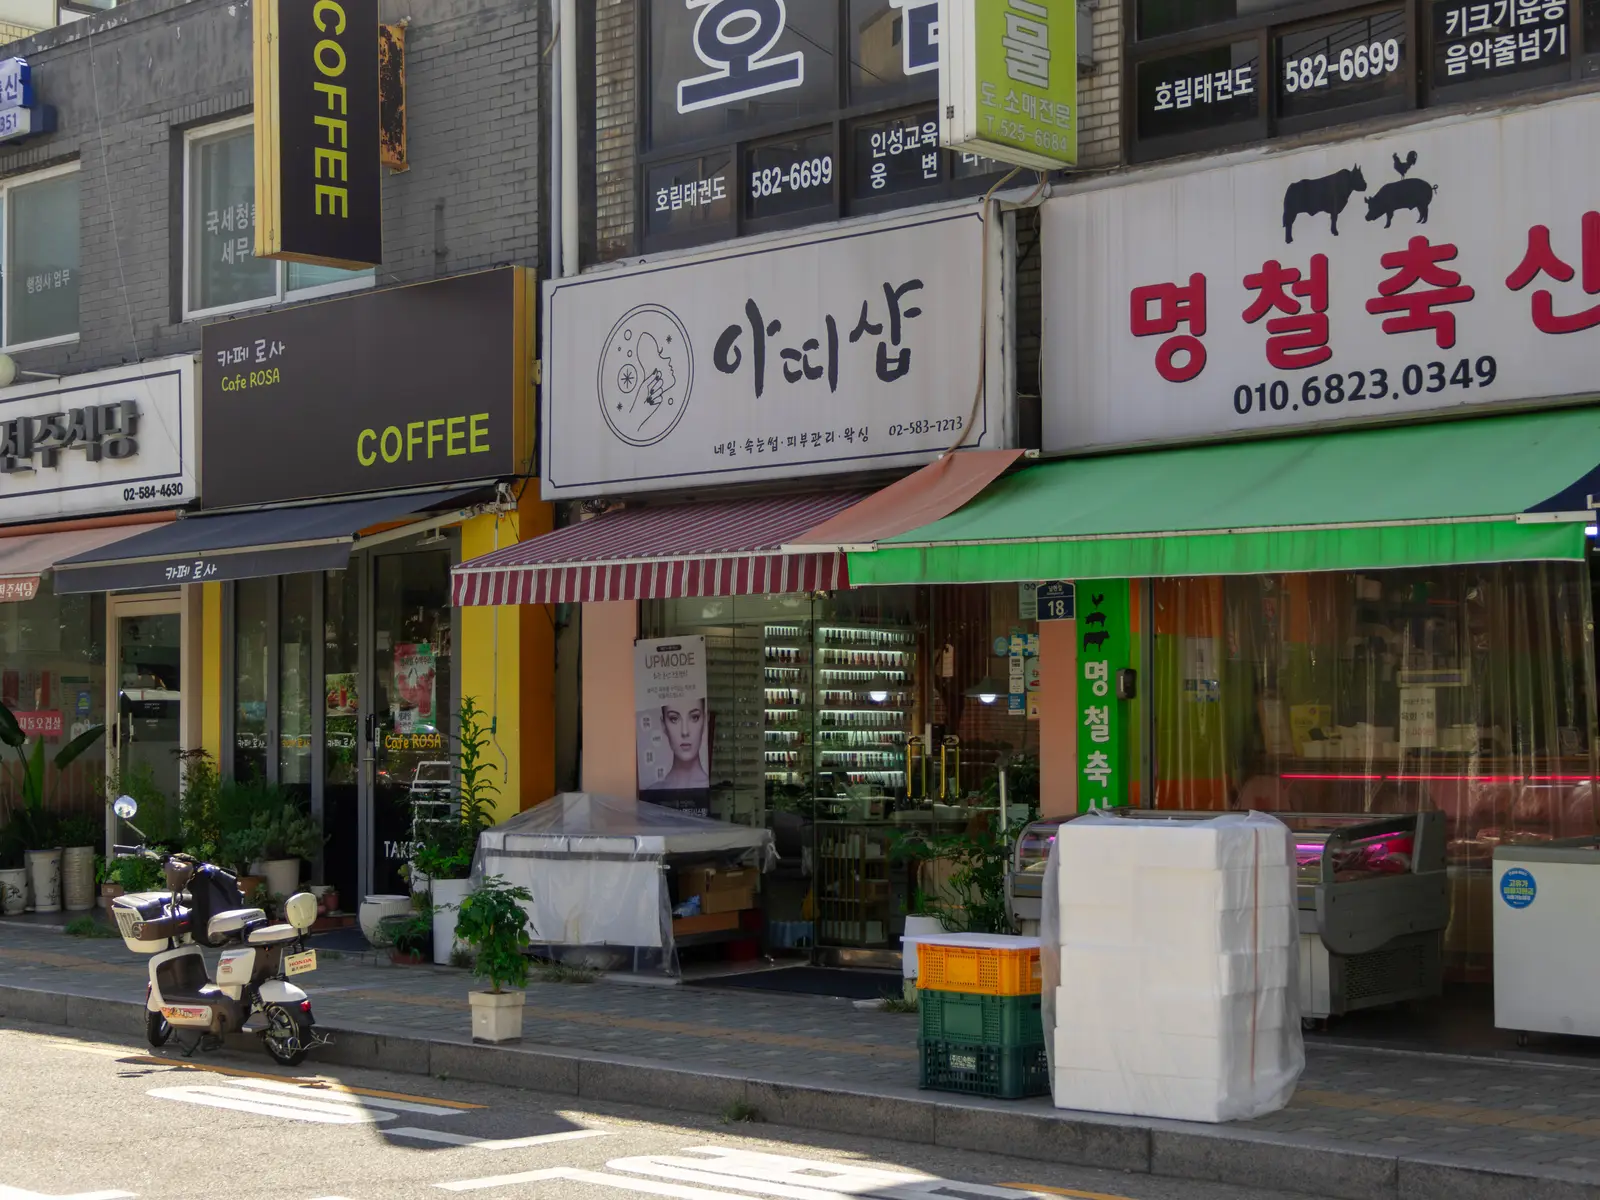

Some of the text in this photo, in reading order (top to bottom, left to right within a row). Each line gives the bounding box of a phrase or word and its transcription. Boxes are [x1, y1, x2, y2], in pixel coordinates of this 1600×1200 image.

[1285, 38, 1399, 93] 582-6699
[1445, 23, 1567, 76] 음악줄넘기
[0, 72, 18, 101] 신
[1154, 66, 1254, 111] 호림태권도
[313, 0, 348, 218] COFFEE
[870, 120, 938, 158] 인성교육
[751, 156, 833, 198] 582-6699
[655, 176, 726, 211] 호림태권도
[26, 269, 70, 294] 행정사 업무
[217, 339, 286, 367] 카페 로사
[713, 278, 924, 399] 아띠샵
[221, 367, 280, 392] Cafe ROSA
[1233, 354, 1498, 416] 010.6823.0349
[0, 399, 139, 474] 전주식당
[356, 412, 490, 467] COFFEE
[888, 416, 963, 438] 02-583-7273
[123, 482, 183, 501] 02-584-4630
[165, 561, 218, 580] 카페 로사
[1047, 599, 1065, 616] 18
[645, 652, 695, 669] UPMODE
[384, 733, 442, 749] Cafe ROSA
[289, 957, 313, 968] HONDA
